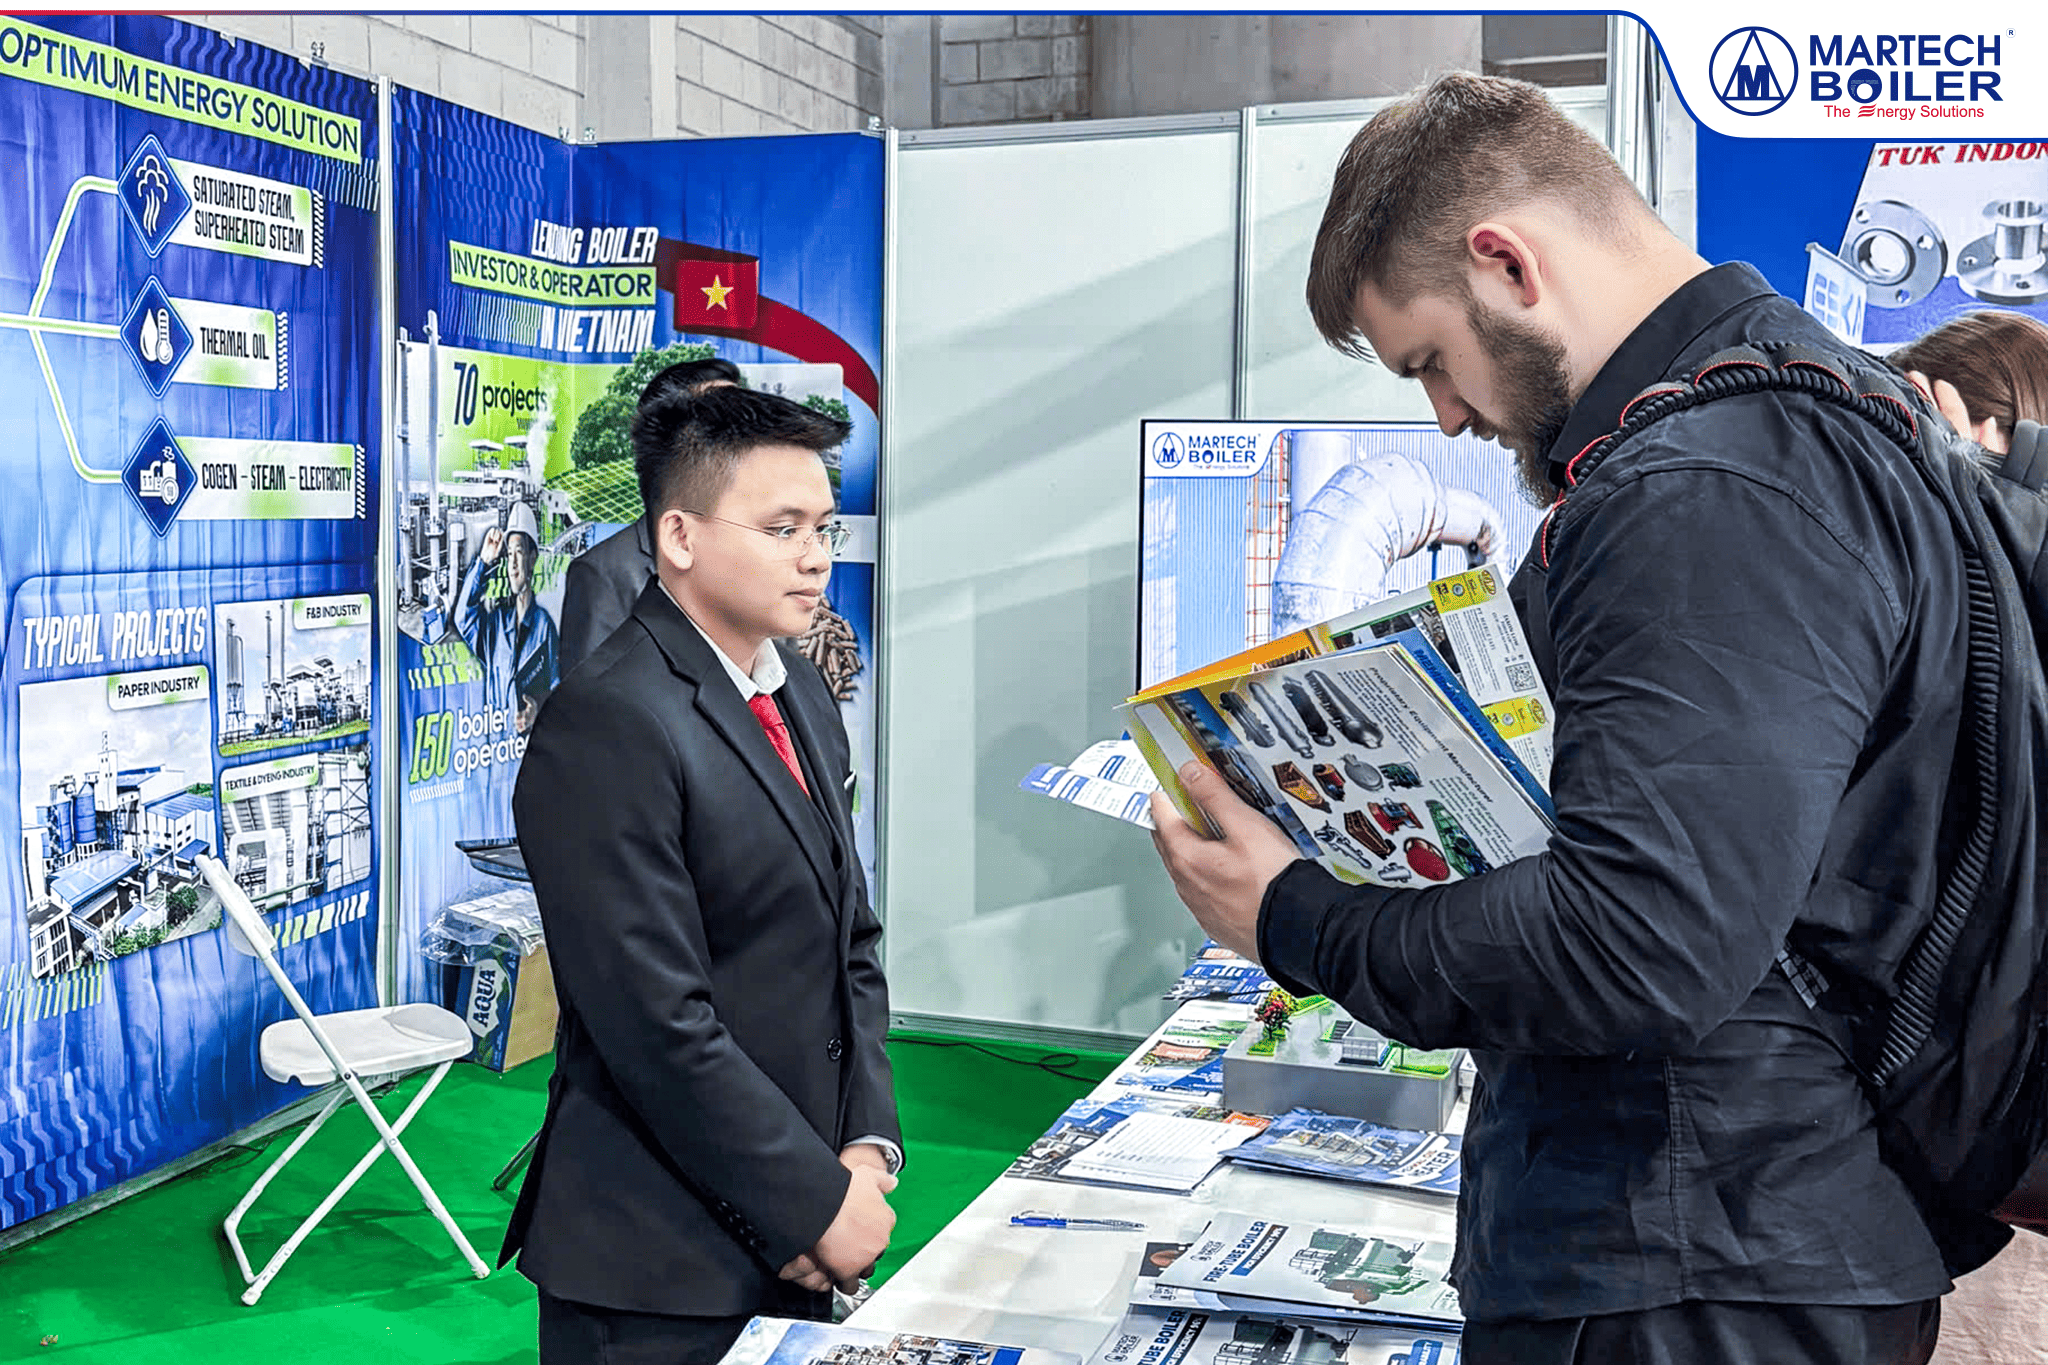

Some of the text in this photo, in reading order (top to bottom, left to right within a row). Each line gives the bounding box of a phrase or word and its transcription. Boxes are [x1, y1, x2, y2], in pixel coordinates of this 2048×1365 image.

[0, 27, 358, 154] OPTIMUM ENERGY SOLUTION
[1872, 145, 1945, 167] TUK
[193, 175, 296, 223] SATURATED STEAM,
[194, 210, 305, 254] SUPERHEATED STEAM
[586, 227, 659, 263] BOILER
[452, 248, 652, 297] INVESTOR & OPERATOR
[200, 327, 270, 360] THERMAL OIL
[557, 308, 656, 353] VIETNAM
[454, 361, 548, 426] 70 projects
[1188, 435, 1256, 449] MARTECH
[1189, 450, 1256, 464] BOILER
[202, 463, 237, 490] COGEN
[251, 464, 286, 491] STEAM
[299, 466, 352, 492] ELECTRICITY
[306, 603, 362, 620] F&B INDUSTRY
[23, 607, 207, 670] TYPICAL PROJECTS
[117, 676, 200, 699] PAPER INDUSTRY
[408, 704, 510, 784] 150 boiler
[1368, 667, 1410, 709] Proprietary
[1446, 753, 1493, 802] Manufacturer
[225, 776, 251, 791] TEXTILE
[282, 764, 315, 782] INDUSTRY
[472, 969, 496, 1028] AQUA
[1203, 1221, 1268, 1282] FIRE-TUBE BOILER
[1154, 1310, 1187, 1344] BOILER
